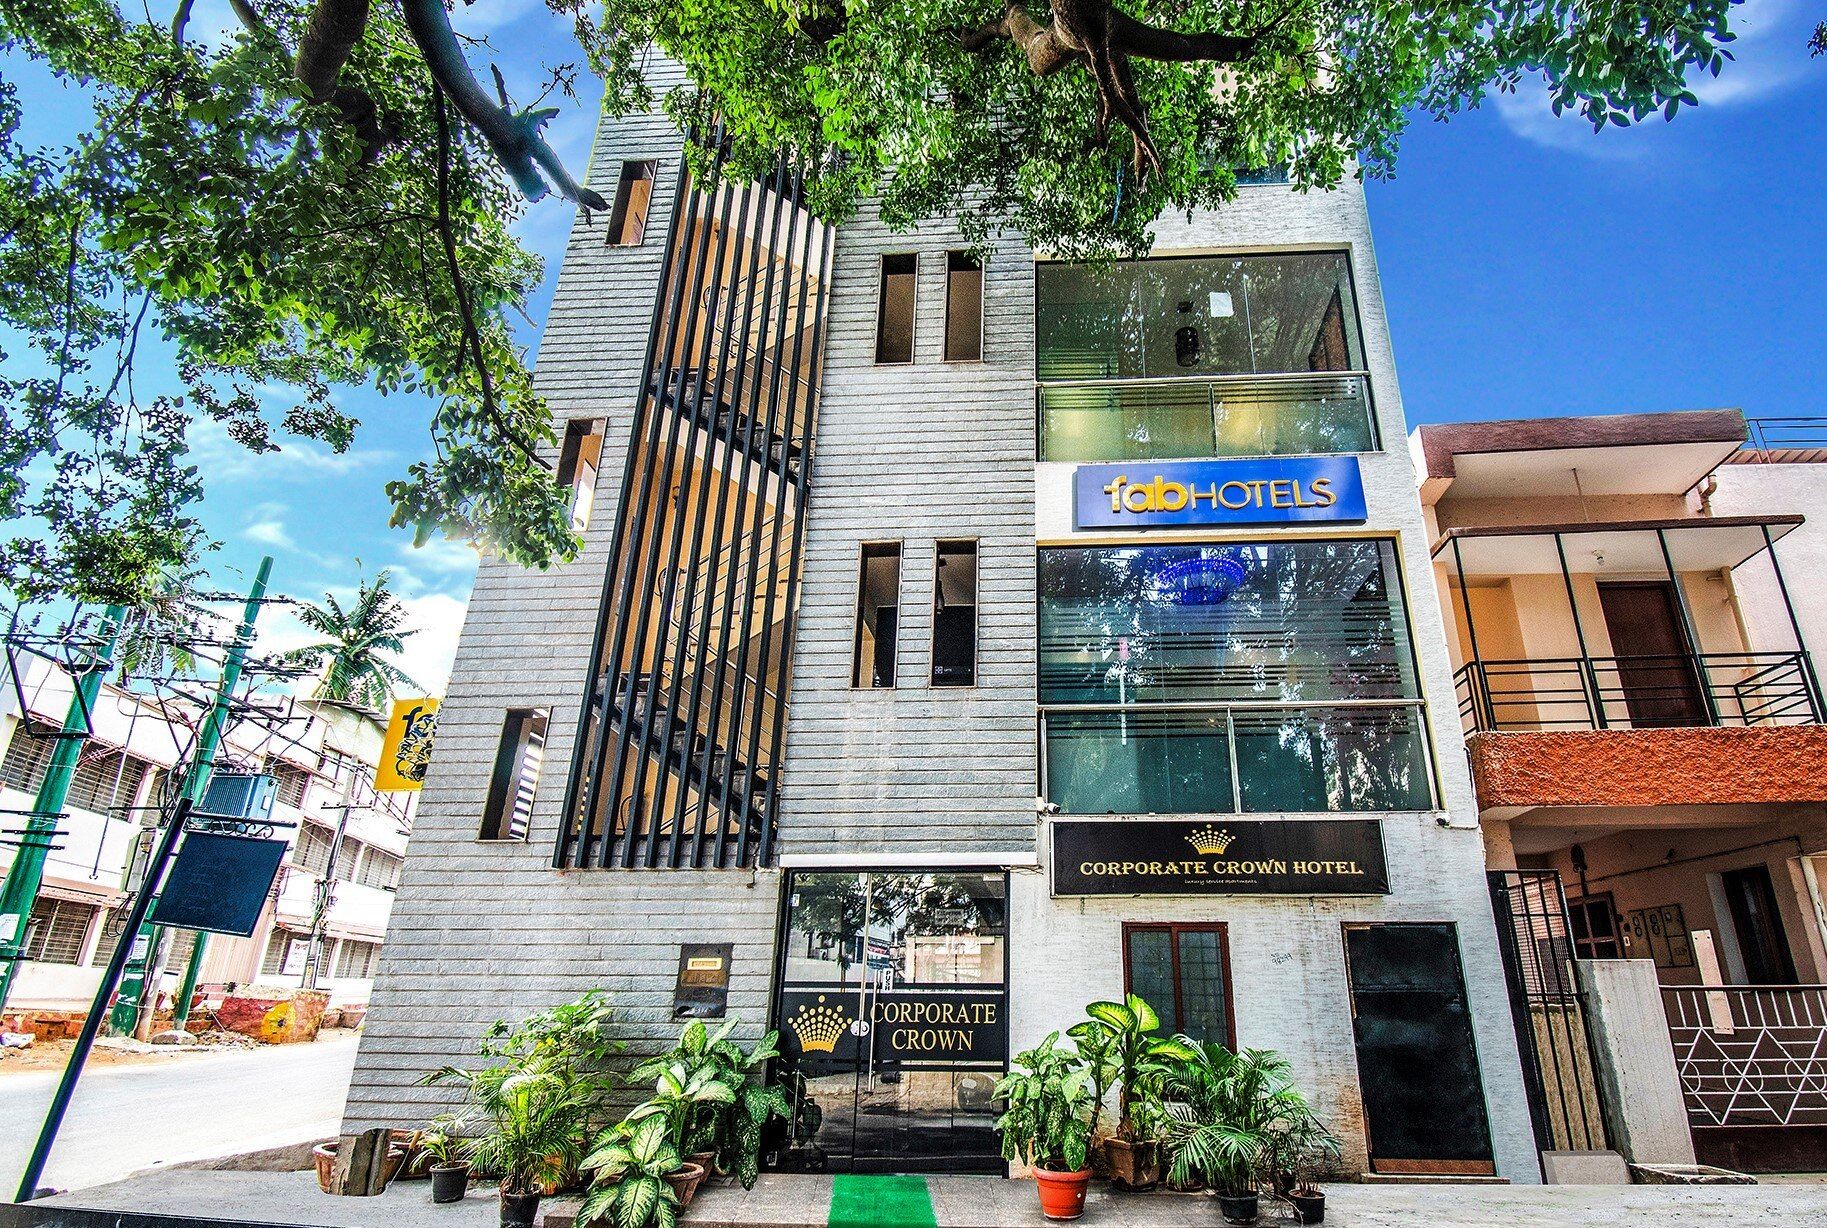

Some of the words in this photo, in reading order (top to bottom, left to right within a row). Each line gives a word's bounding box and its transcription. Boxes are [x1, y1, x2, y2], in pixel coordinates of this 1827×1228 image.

[1103, 475, 1338, 513] fabHOTELS
[1080, 861, 1209, 876] CORPORATE
[1213, 859, 1287, 875] CROWN
[1293, 861, 1364, 875] HOTEL
[870, 1002, 997, 1024] CORPORATE
[892, 1029, 974, 1051] CROWN
